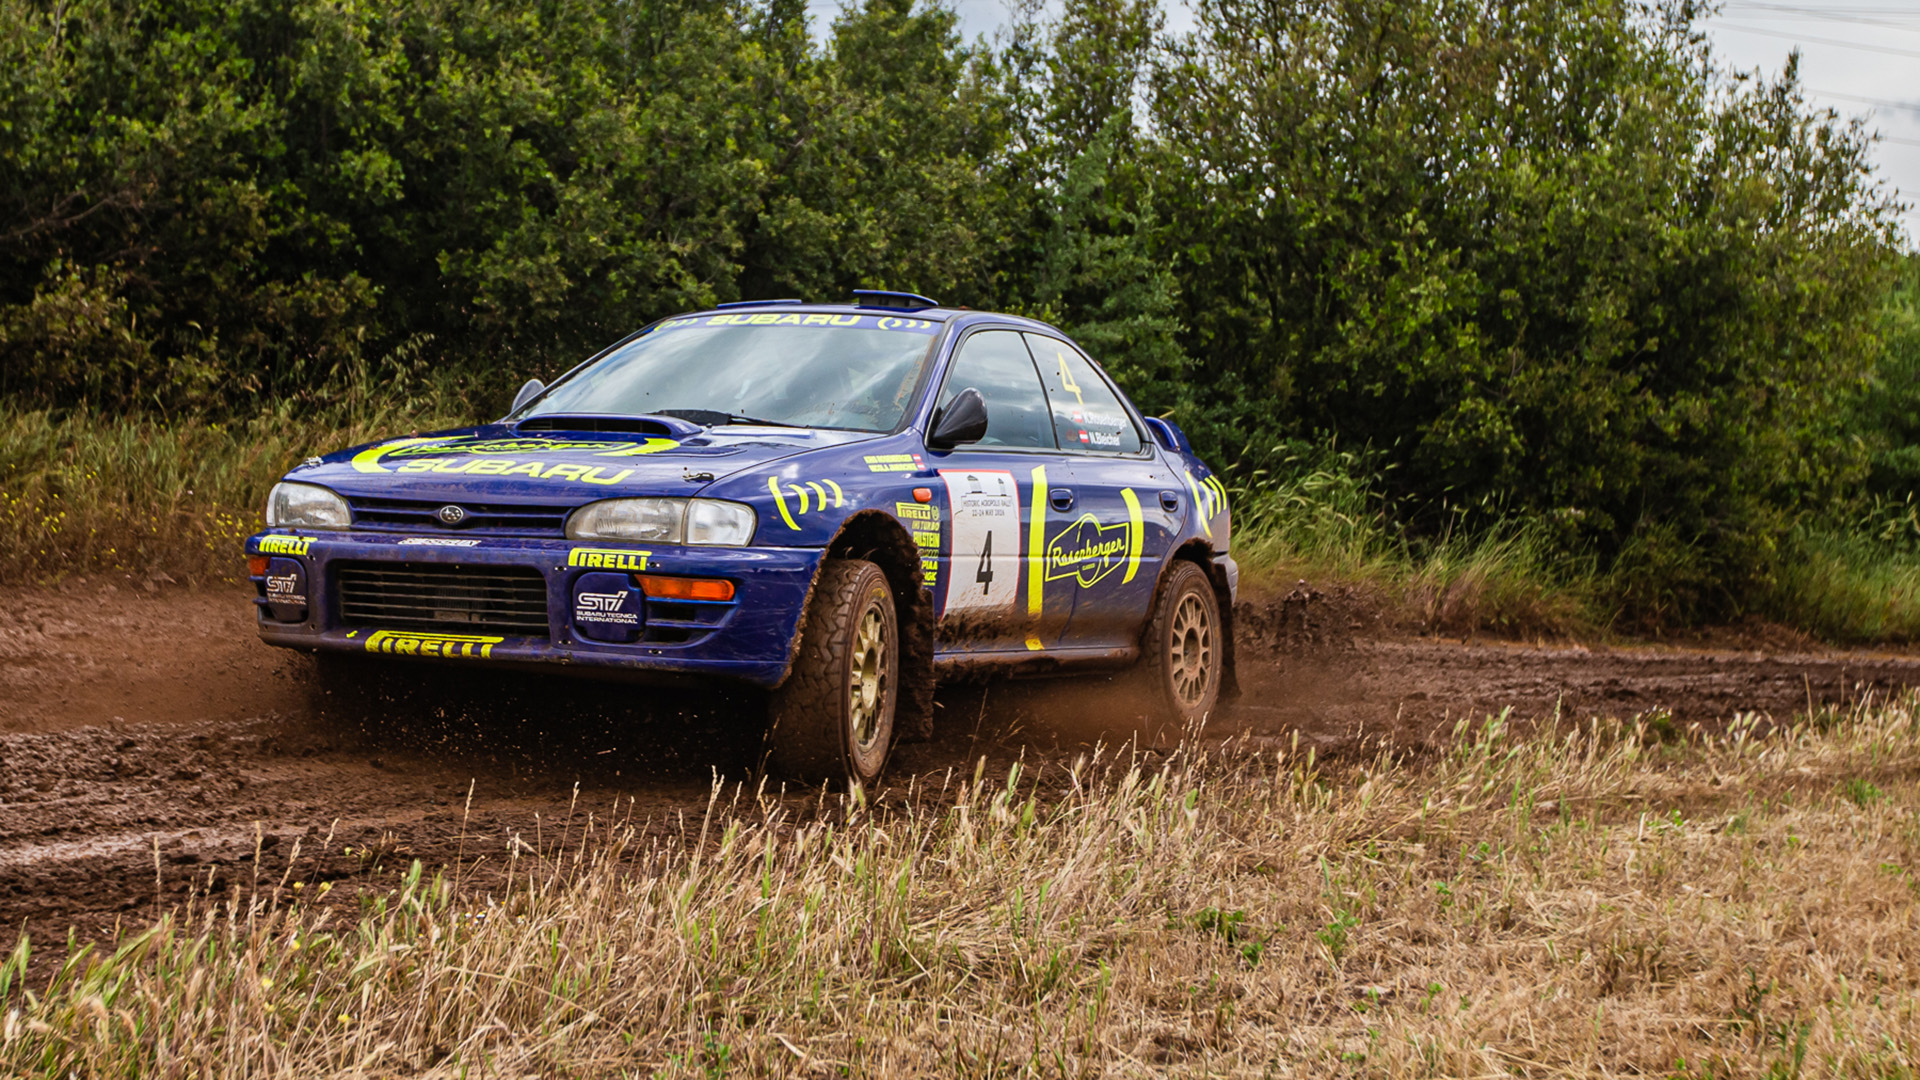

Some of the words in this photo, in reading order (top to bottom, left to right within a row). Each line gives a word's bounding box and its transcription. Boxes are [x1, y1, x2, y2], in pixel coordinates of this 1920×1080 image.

[706, 313, 862, 327] SUBARU
[1057, 351, 1084, 406] 4
[397, 458, 636, 486] SUBARU
[895, 501, 931, 520] PIRELLI
[258, 533, 319, 556] PIRELLI
[1052, 537, 1125, 569] Rosenberger
[567, 547, 653, 571] PIRELLI
[921, 560, 939, 571] PIAA
[976, 530, 993, 595] 4
[576, 610, 606, 618] SUBARU
[606, 612, 638, 620] TECNICA
[576, 615, 638, 625] INTERNATIONAL
[364, 629, 505, 659] PIRELLI
